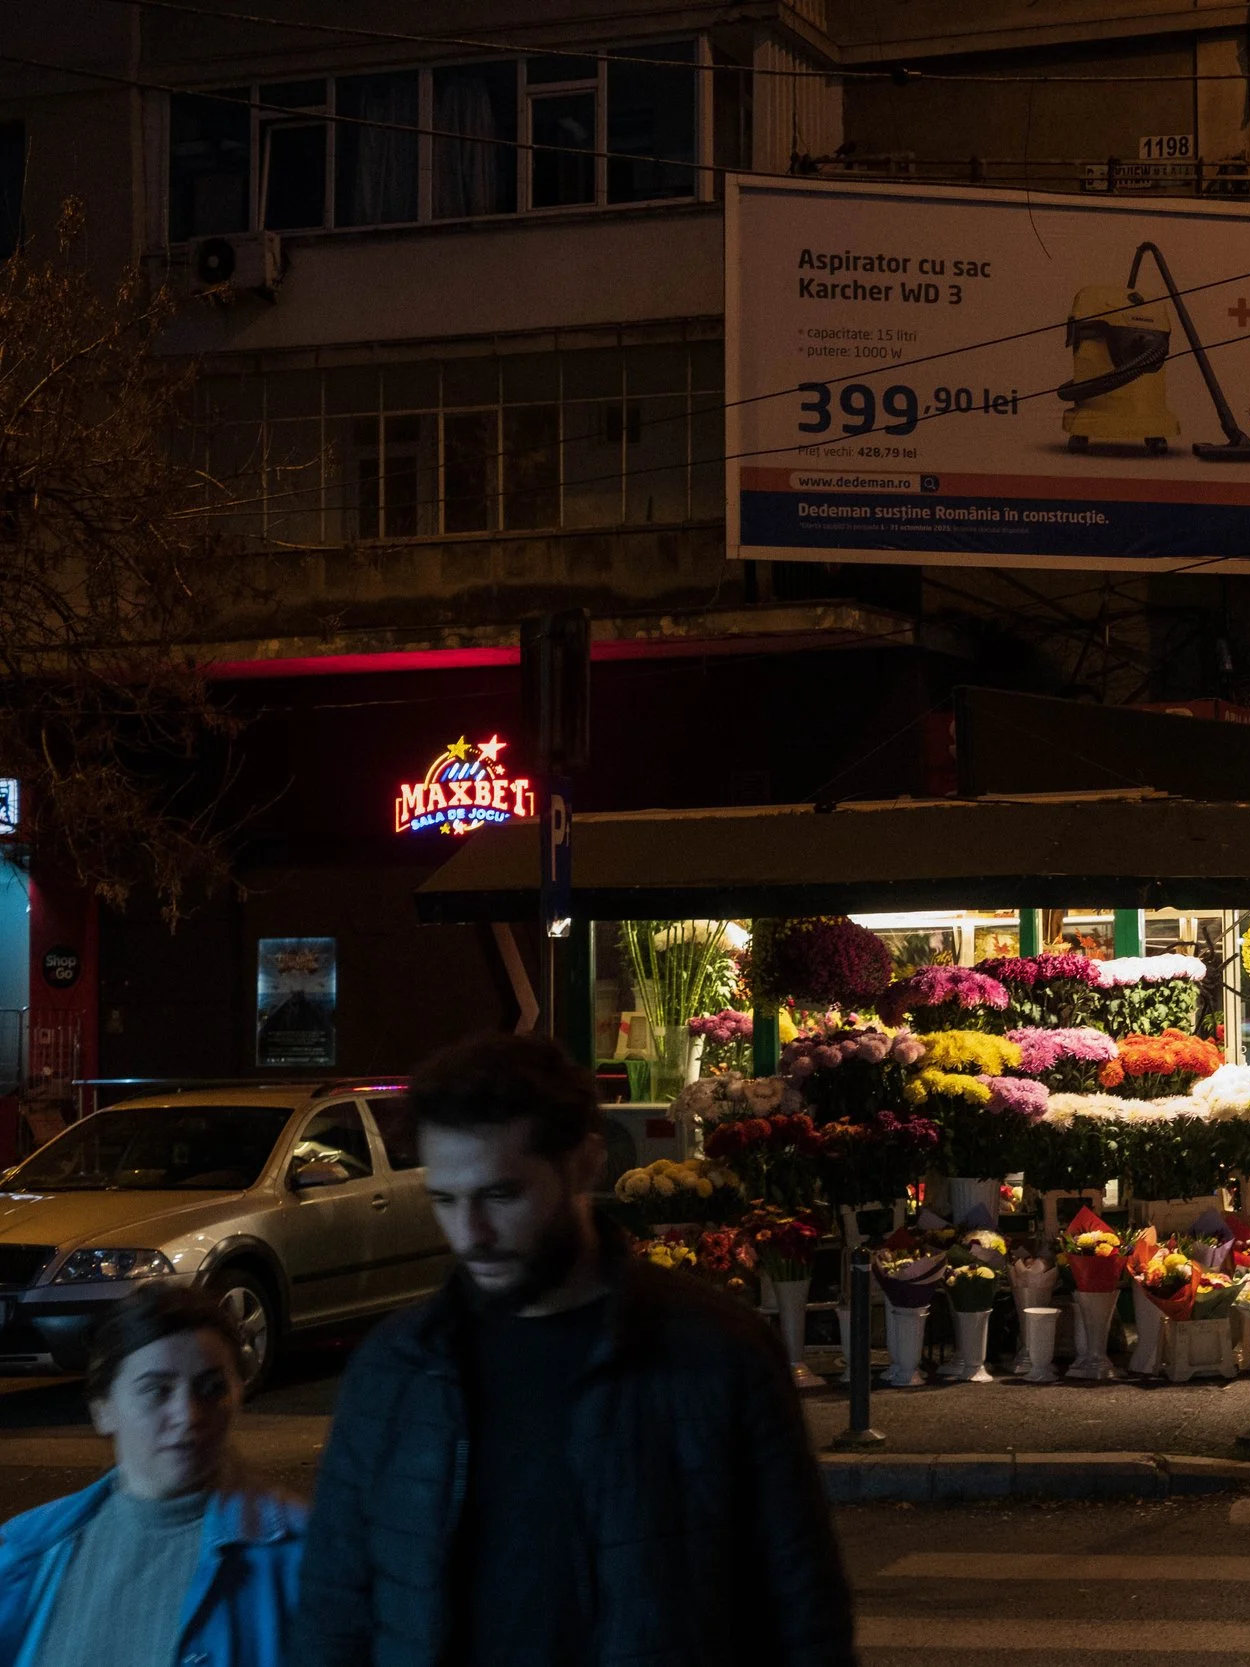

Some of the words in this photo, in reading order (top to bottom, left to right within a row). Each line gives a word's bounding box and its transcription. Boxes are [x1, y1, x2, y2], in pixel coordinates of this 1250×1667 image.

[1143, 136, 1190, 158] 1198
[798, 249, 910, 276] Aspirator
[918, 258, 946, 276] cu
[952, 258, 992, 279] sac
[798, 277, 893, 303] Karcher
[900, 282, 940, 304] WD
[948, 284, 963, 305] 3
[806, 327, 873, 342] capacitate:
[878, 328, 893, 341] 15
[897, 329, 917, 342] litri
[806, 345, 851, 358] putere:
[855, 345, 888, 359] 1000
[891, 347, 903, 360] W
[983, 388, 1019, 416] lei
[823, 445, 855, 458] vechi:
[857, 446, 900, 459] 428,79
[902, 447, 918, 459] lei
[798, 475, 912, 490] www.dedeman.ro
[797, 502, 871, 520] Dedeman
[874, 503, 932, 523] susține
[935, 505, 1000, 522] România
[1004, 507, 1019, 523] în
[1023, 508, 1110, 528] construcție.
[399, 778, 530, 825] MAXBET
[409, 810, 447, 832] SALA
[447, 808, 467, 820] DE
[550, 793, 567, 882] P
[45, 953, 78, 970] Shop
